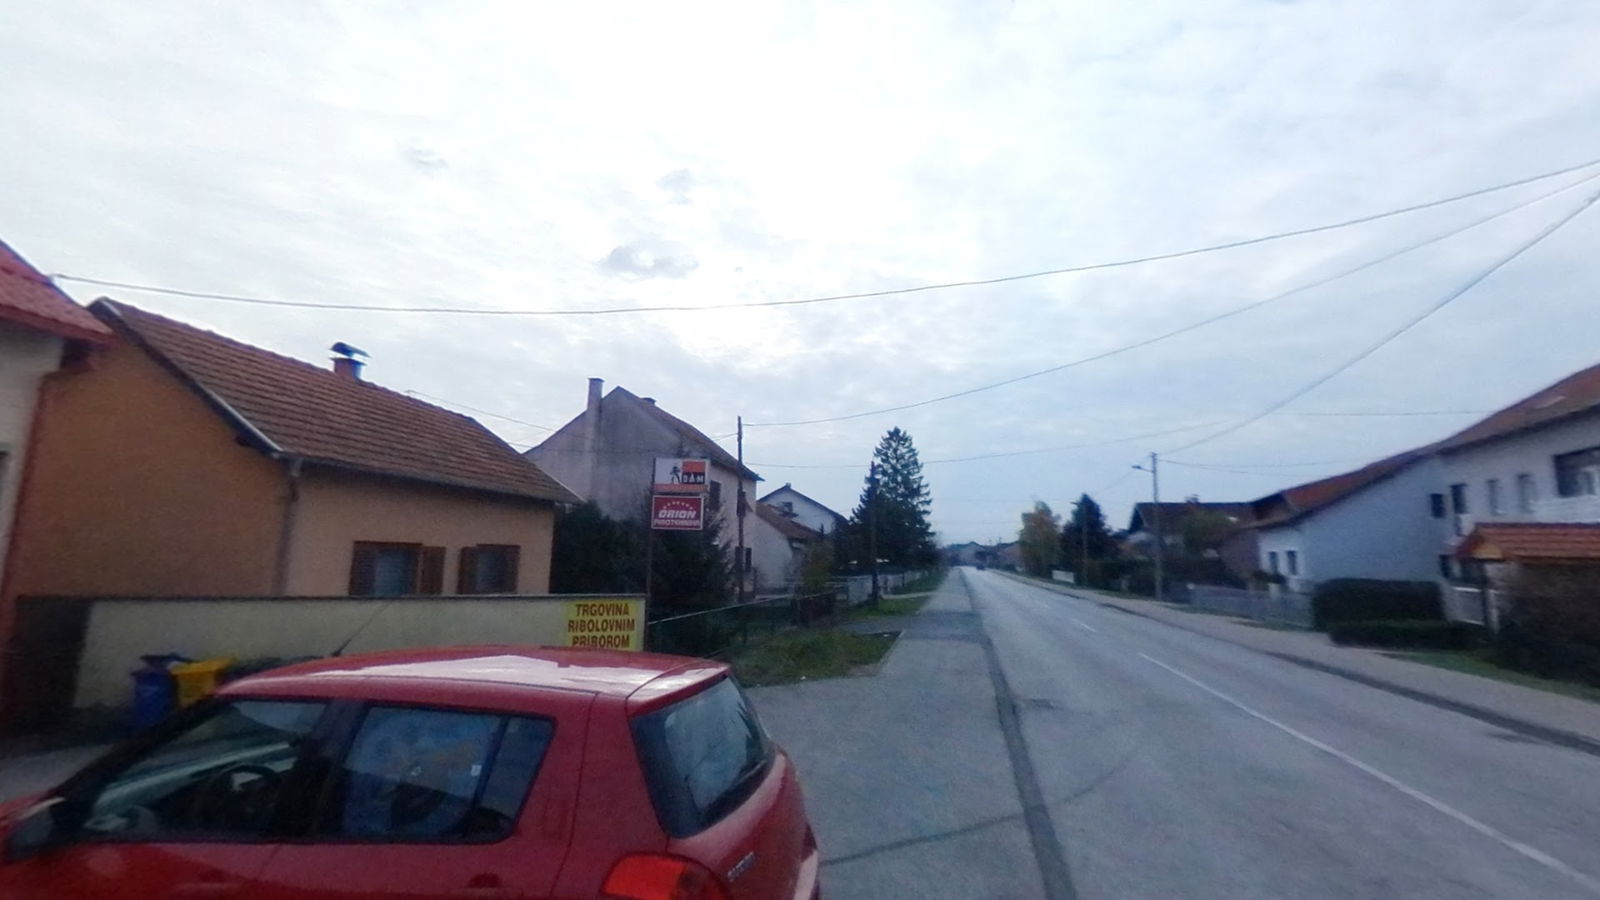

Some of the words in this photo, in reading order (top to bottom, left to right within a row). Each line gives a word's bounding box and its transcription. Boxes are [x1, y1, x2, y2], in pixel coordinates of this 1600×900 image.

[658, 510, 697, 519] ORION
[576, 603, 629, 616] TRGOVINA
[568, 619, 635, 632] RIBOLOVNIM
[572, 635, 630, 648] PRIBOROM
